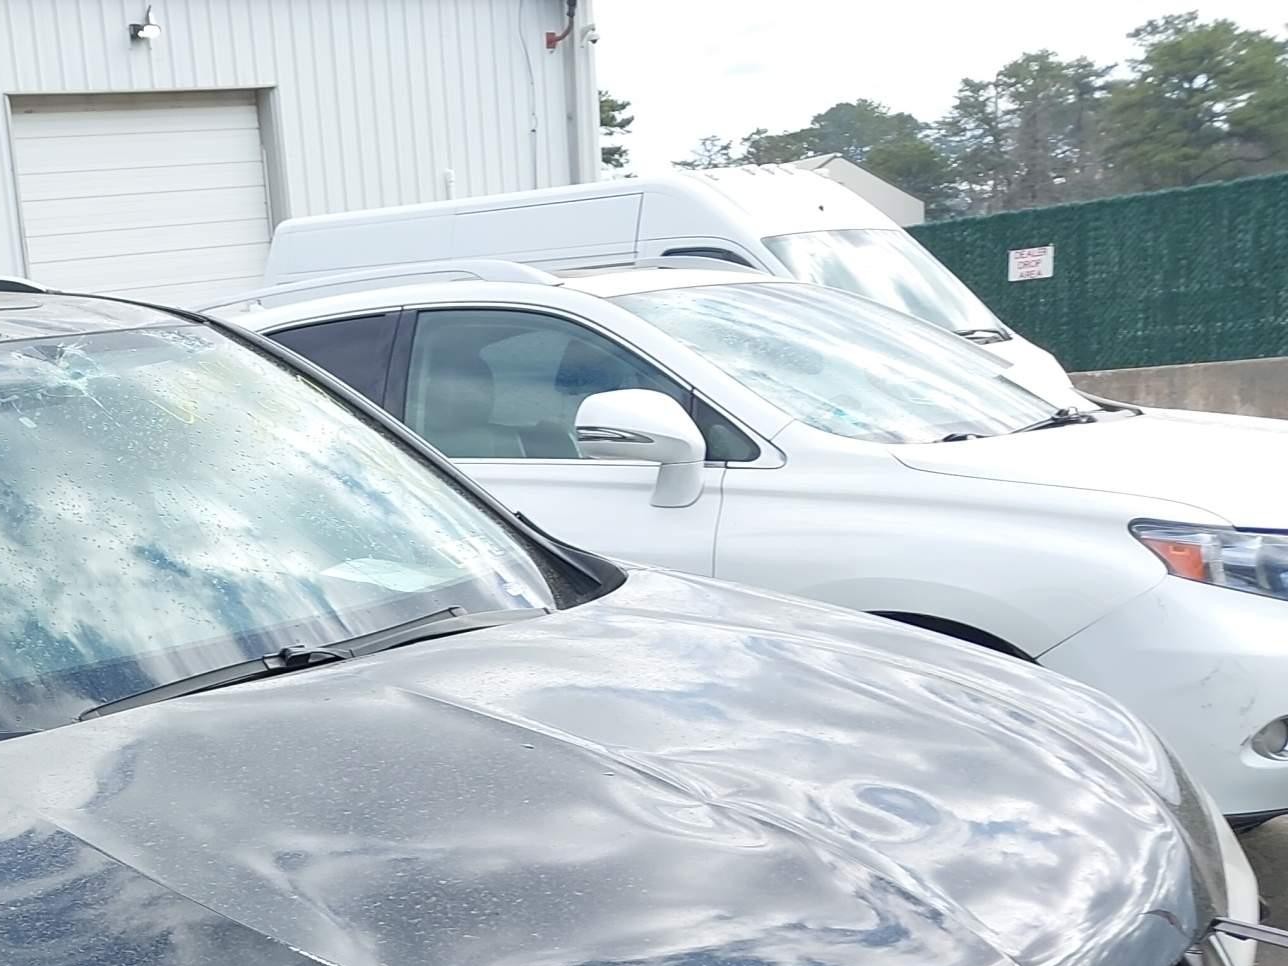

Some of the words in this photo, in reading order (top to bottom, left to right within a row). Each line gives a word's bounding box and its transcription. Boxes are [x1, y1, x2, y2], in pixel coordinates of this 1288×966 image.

[1014, 248, 1048, 260] DEALER
[1017, 259, 1041, 270] DROP
[1019, 270, 1043, 279] AREA
